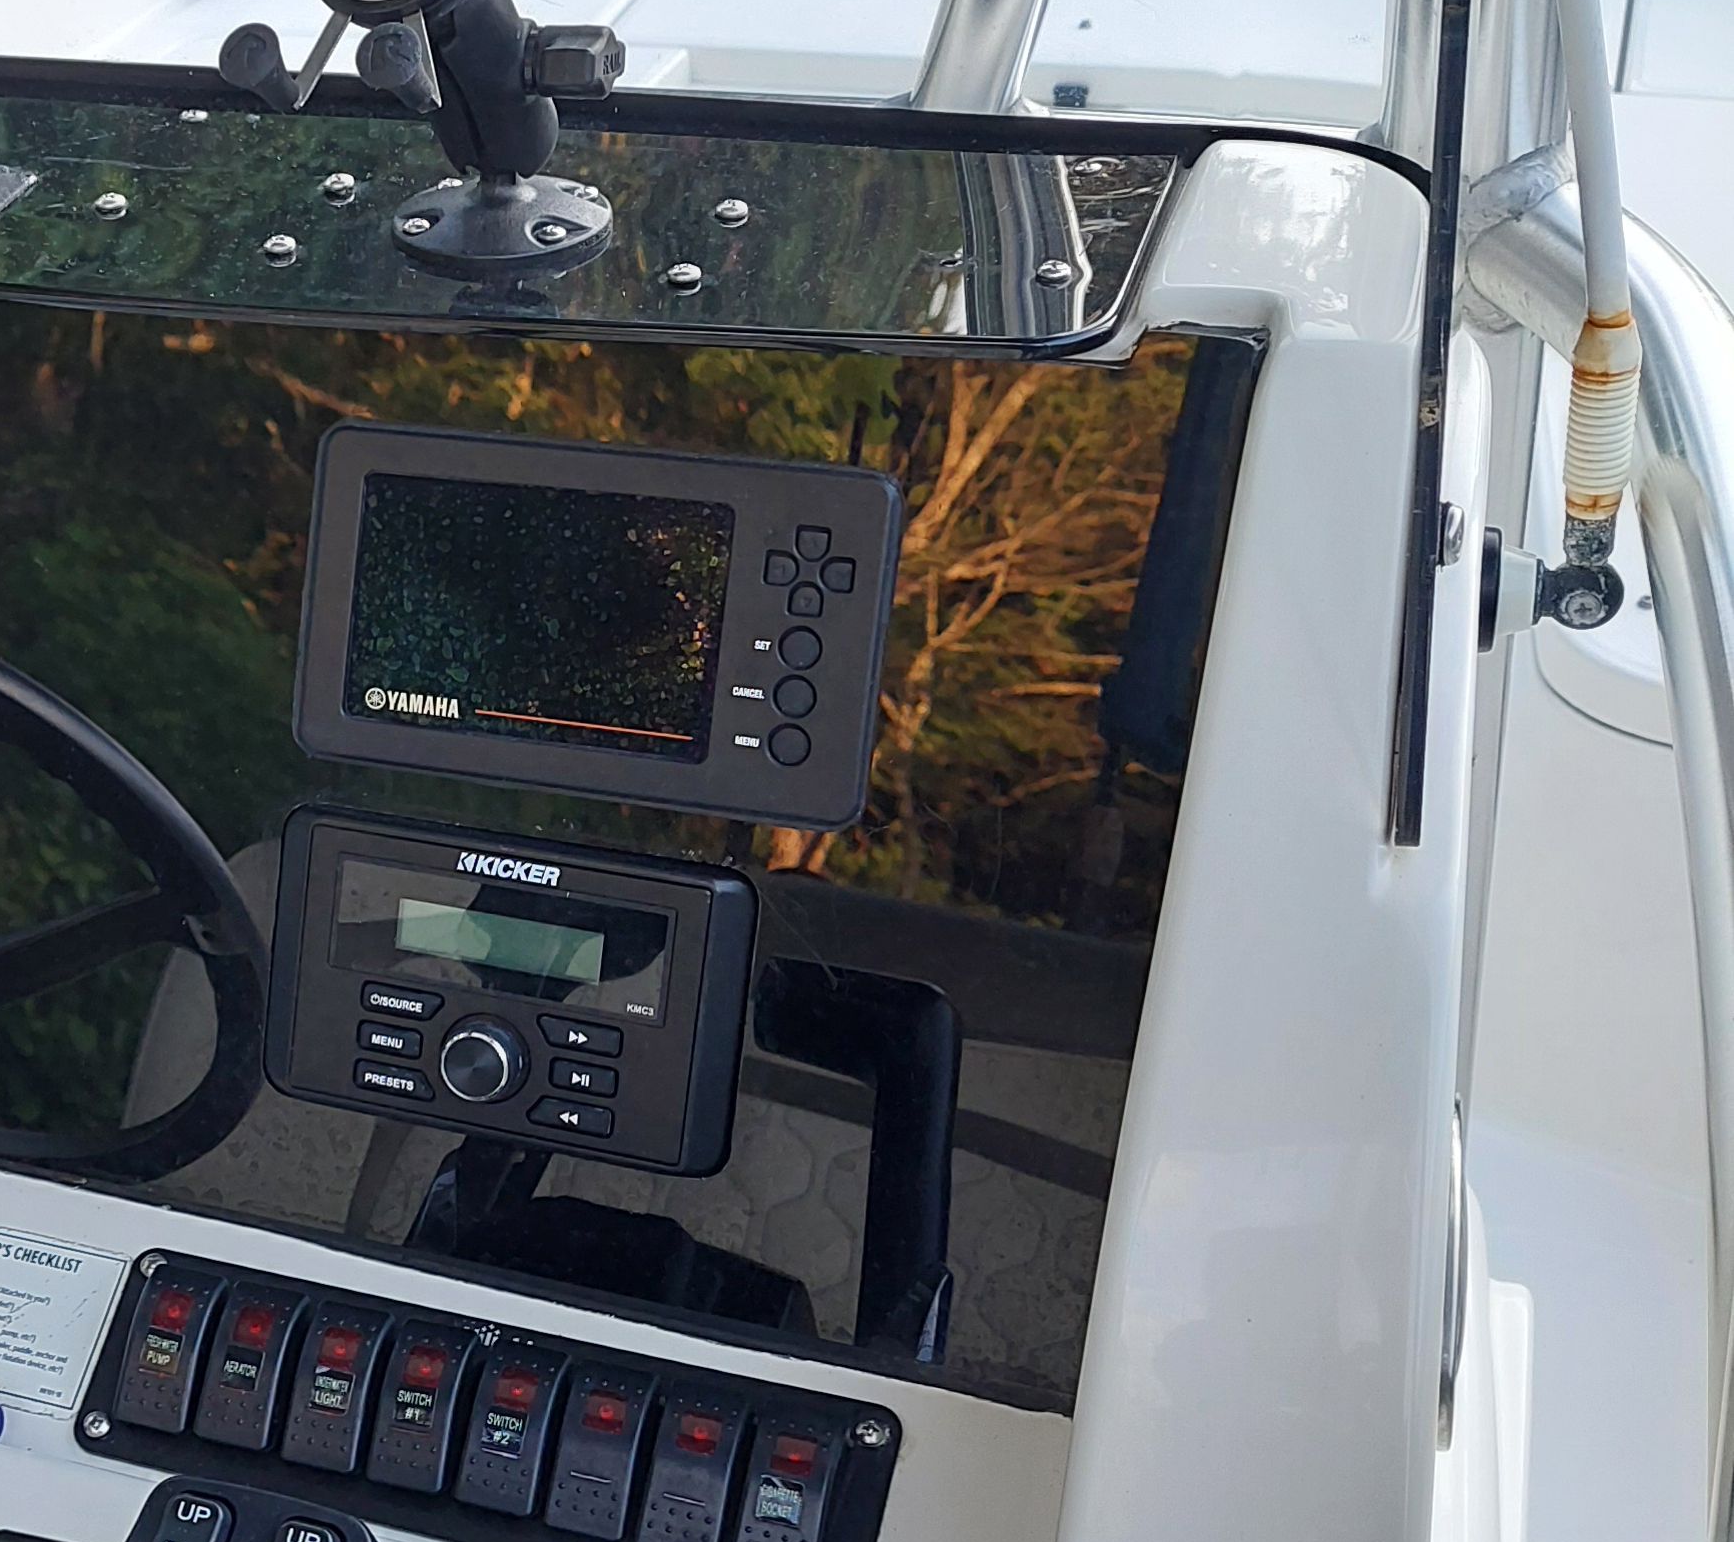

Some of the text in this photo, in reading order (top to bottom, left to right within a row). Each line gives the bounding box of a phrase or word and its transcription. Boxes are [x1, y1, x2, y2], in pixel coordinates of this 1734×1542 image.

[754, 640, 771, 651] SET
[732, 686, 765, 699] CANCEL
[386, 690, 459, 719] YAMAHA
[734, 735, 760, 748] MENU
[474, 854, 561, 887] KICKER
[371, 1034, 403, 1049] MENU
[364, 1072, 415, 1091] PRESETS
[14, 1247, 83, 1274] CHECKLIST
[146, 1349, 171, 1366] PUMP
[223, 1360, 258, 1379] AERATOR
[315, 1390, 343, 1408] LIGHT
[396, 1389, 433, 1407] SWITCH
[404, 1407, 420, 1421] #1
[486, 1412, 523, 1432] SWITCH
[493, 1430, 510, 1445] #2
[177, 1501, 212, 1524] UP
[761, 1501, 793, 1519] SOCKET
